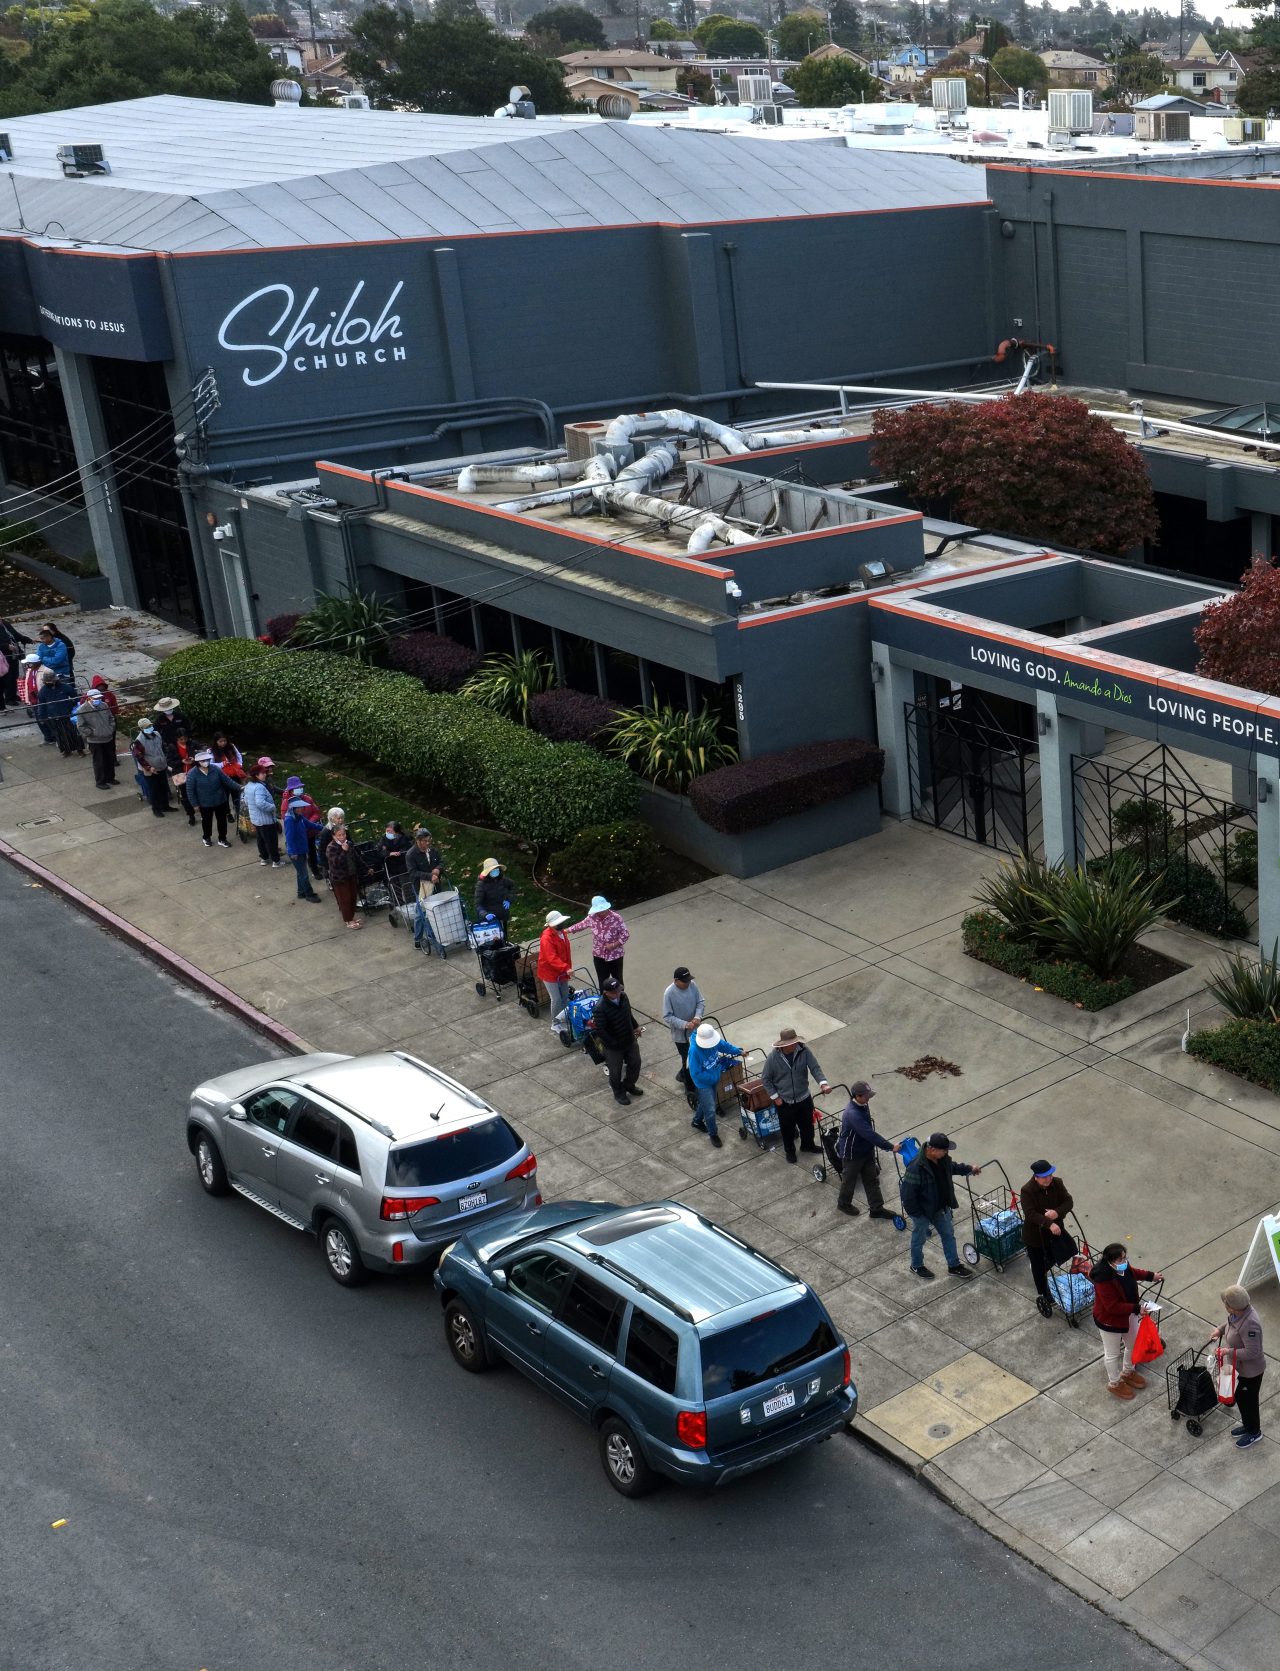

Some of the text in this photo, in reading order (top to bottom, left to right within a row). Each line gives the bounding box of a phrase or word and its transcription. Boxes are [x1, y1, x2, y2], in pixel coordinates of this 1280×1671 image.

[84, 319, 97, 330] TO
[99, 321, 126, 333] JESUS
[217, 280, 404, 387] Shiloh
[293, 346, 407, 372] CHURCH
[970, 645, 1133, 704] LOVING GOD. Amando a Dios
[1148, 695, 1207, 725] LOVING
[1212, 712, 1279, 746] PEOPLE.
